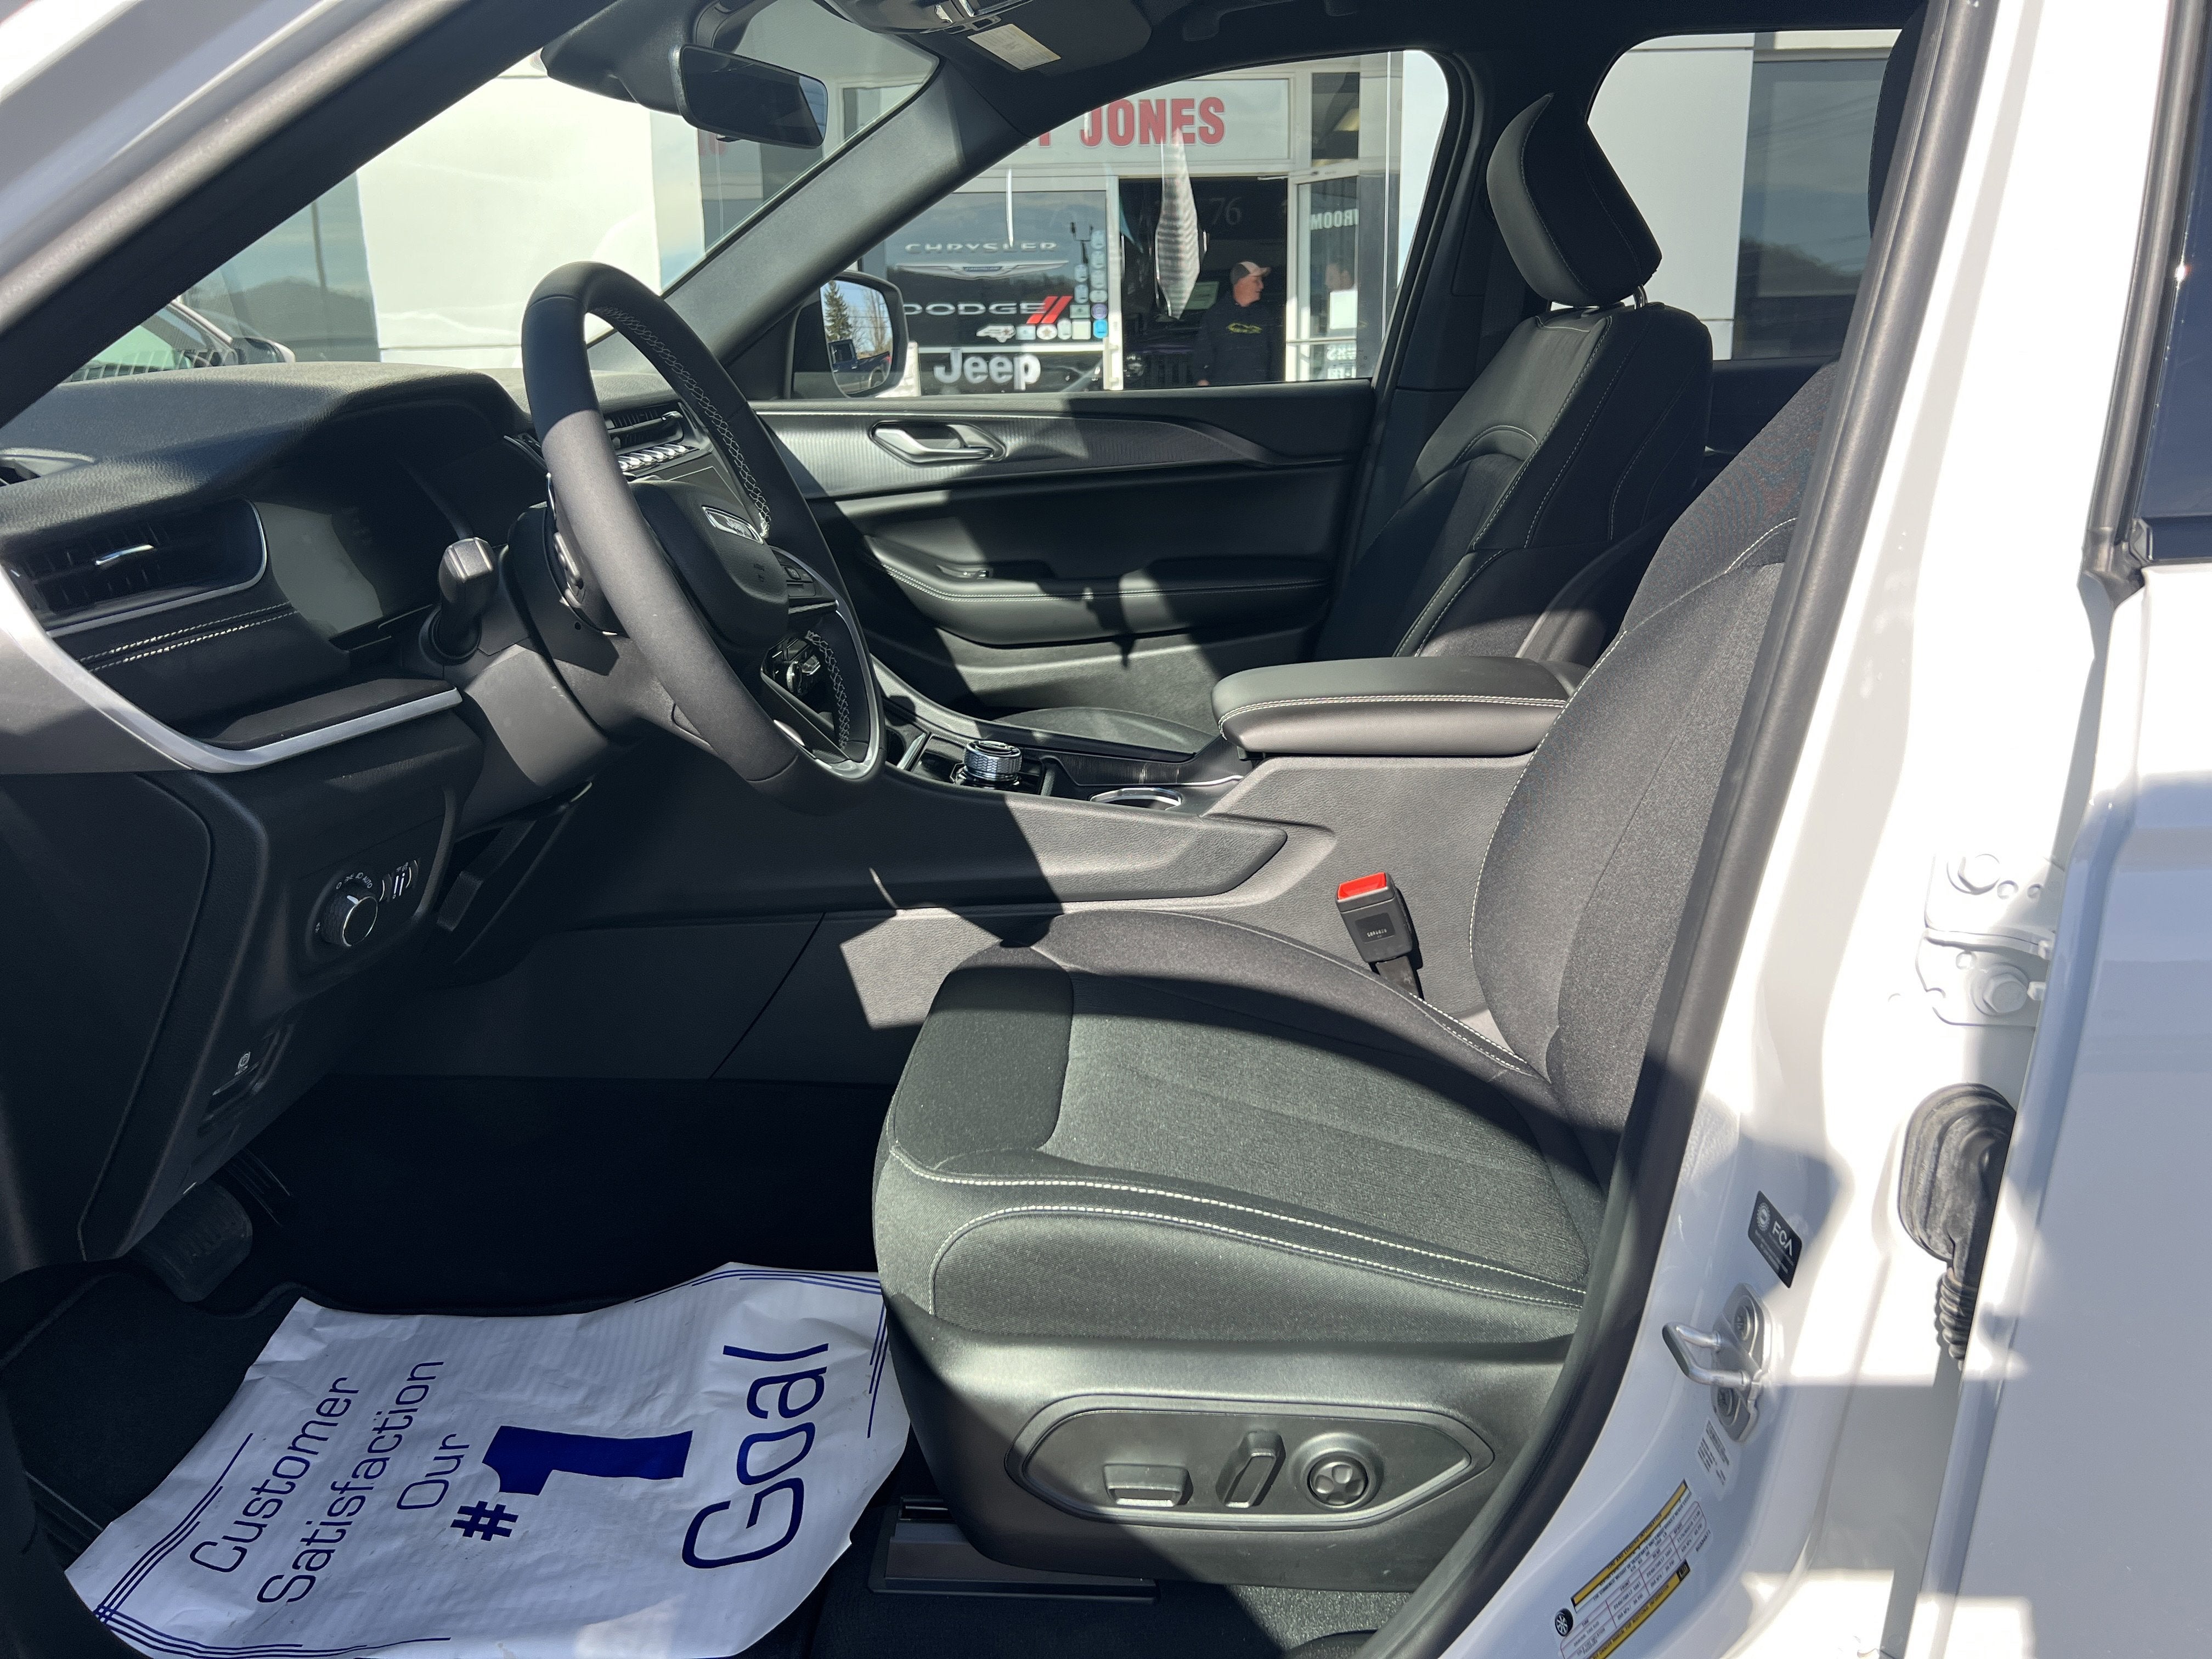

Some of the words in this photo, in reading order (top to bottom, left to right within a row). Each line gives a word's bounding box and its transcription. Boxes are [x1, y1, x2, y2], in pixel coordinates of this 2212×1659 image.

[1080, 97, 1225, 147] JONES
[905, 242, 1058, 253] CHRYSLER
[904, 302, 1046, 316] DODGE
[933, 348, 1041, 391] Jeep
[363, 876, 373, 888] AUTO
[190, 1378, 359, 1572] Customer
[257, 1361, 444, 1603] Satisfaction
[396, 1434, 470, 1510] Our
[450, 1425, 693, 1542] #1
[682, 1343, 828, 1569] Goal
